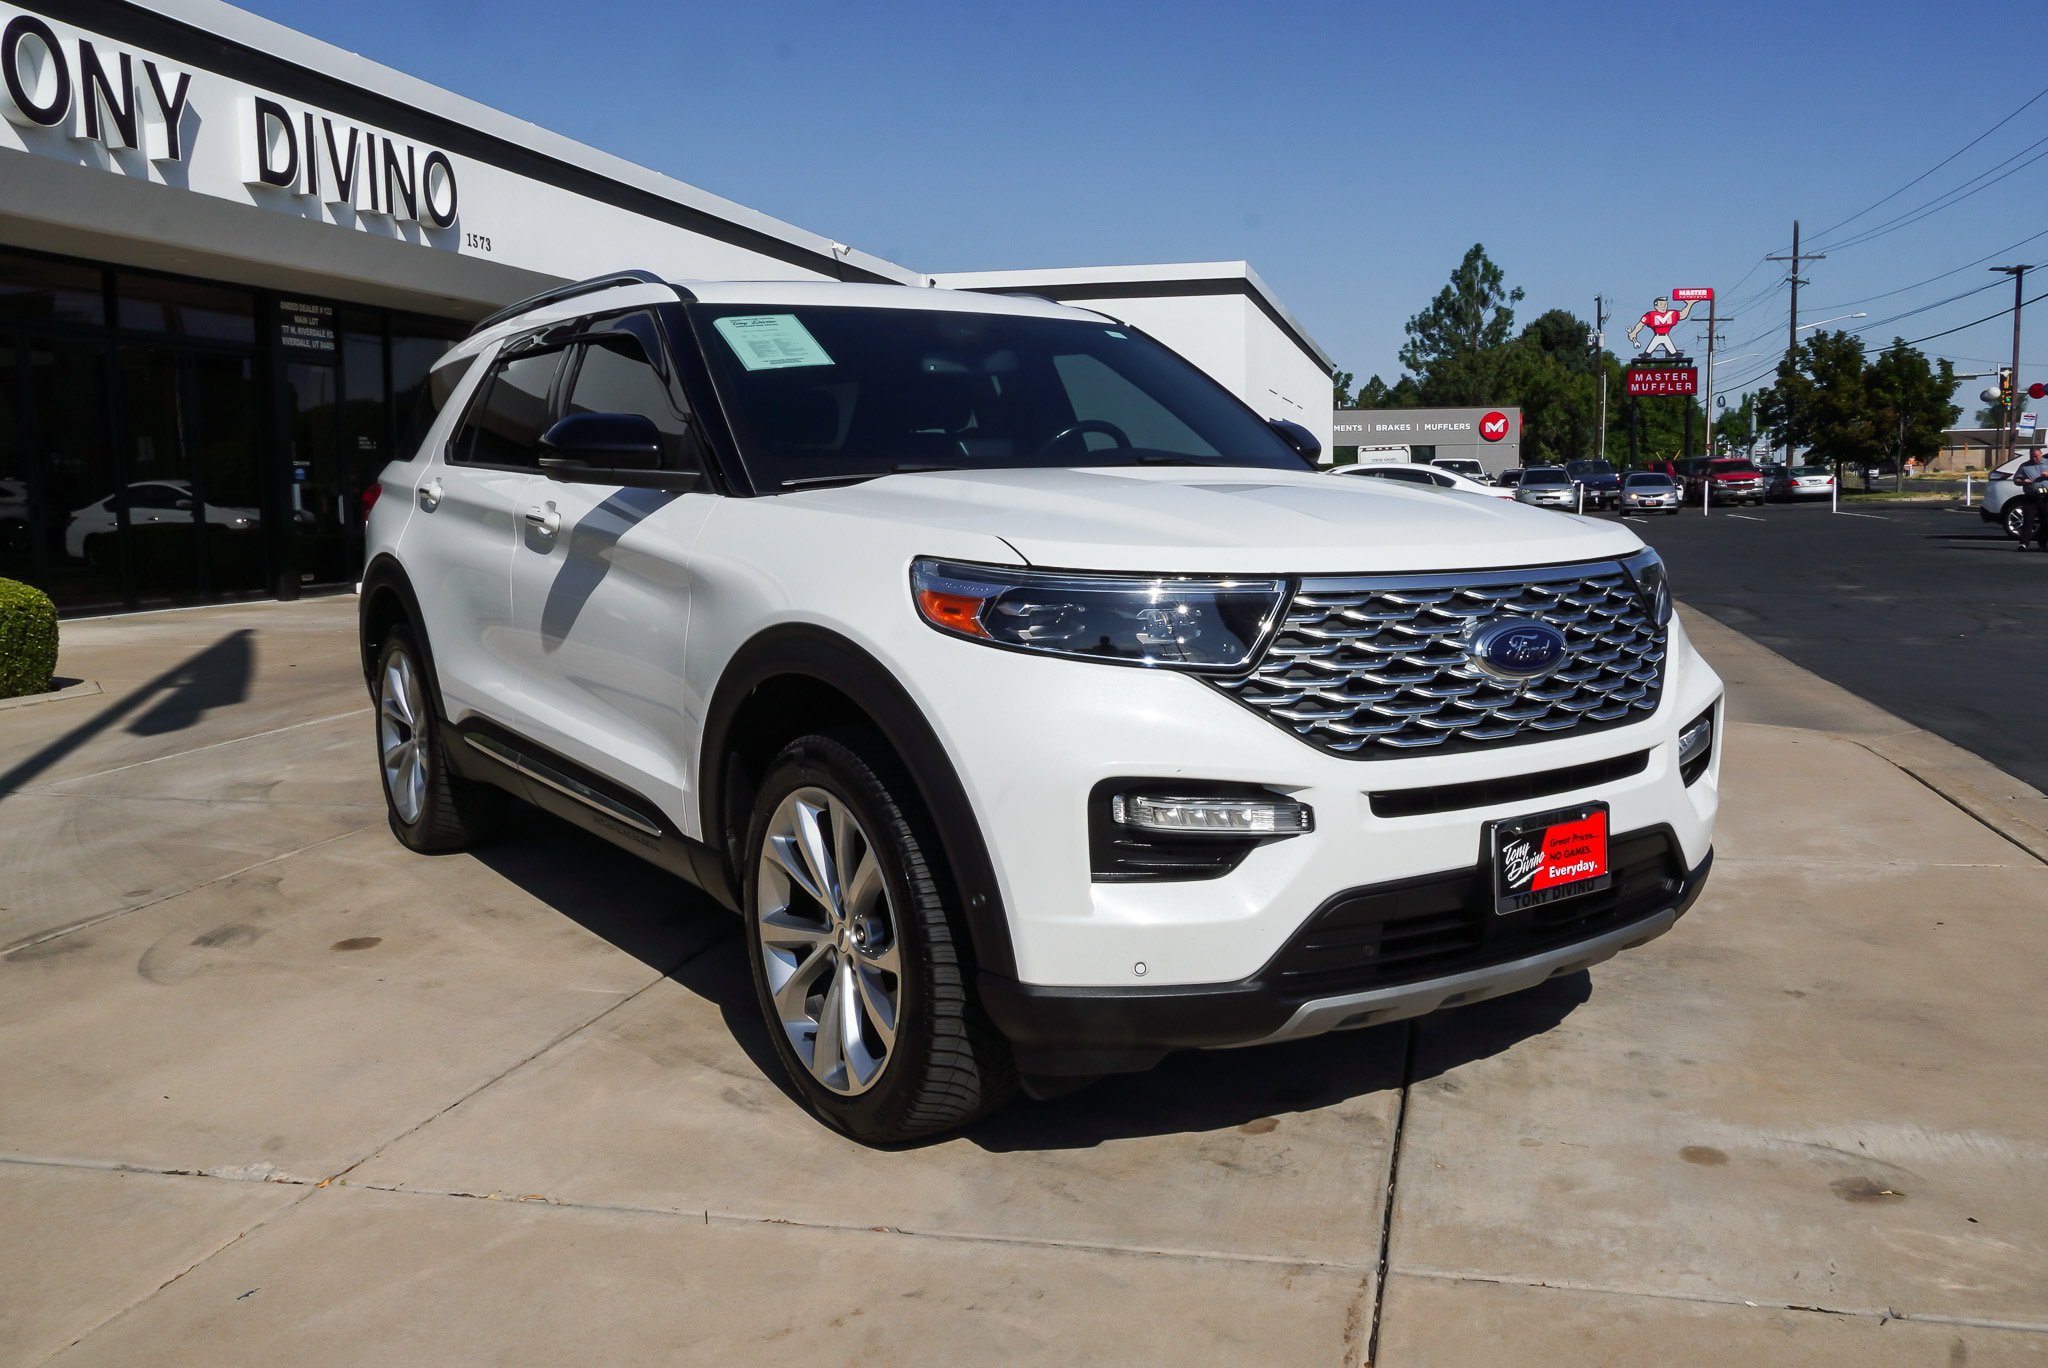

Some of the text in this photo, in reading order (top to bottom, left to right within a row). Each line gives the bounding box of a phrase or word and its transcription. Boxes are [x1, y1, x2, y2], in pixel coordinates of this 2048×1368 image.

[1, 15, 459, 229] ONY DIVINO
[467, 233, 491, 251] 1573
[309, 317, 319, 326] LOT
[298, 327, 326, 338] RIVERDALE
[1635, 373, 1688, 381] MASTER
[1631, 382, 1692, 392] MUFFLER
[1509, 634, 1551, 661] Ford
[1550, 836, 1570, 847] Great
[1502, 839, 1530, 864] Tony
[1550, 852, 1562, 861] NO
[1504, 851, 1546, 881] Divino
[1549, 859, 1598, 878] Everyday.
[1513, 879, 1595, 909] TONY DIVINO
